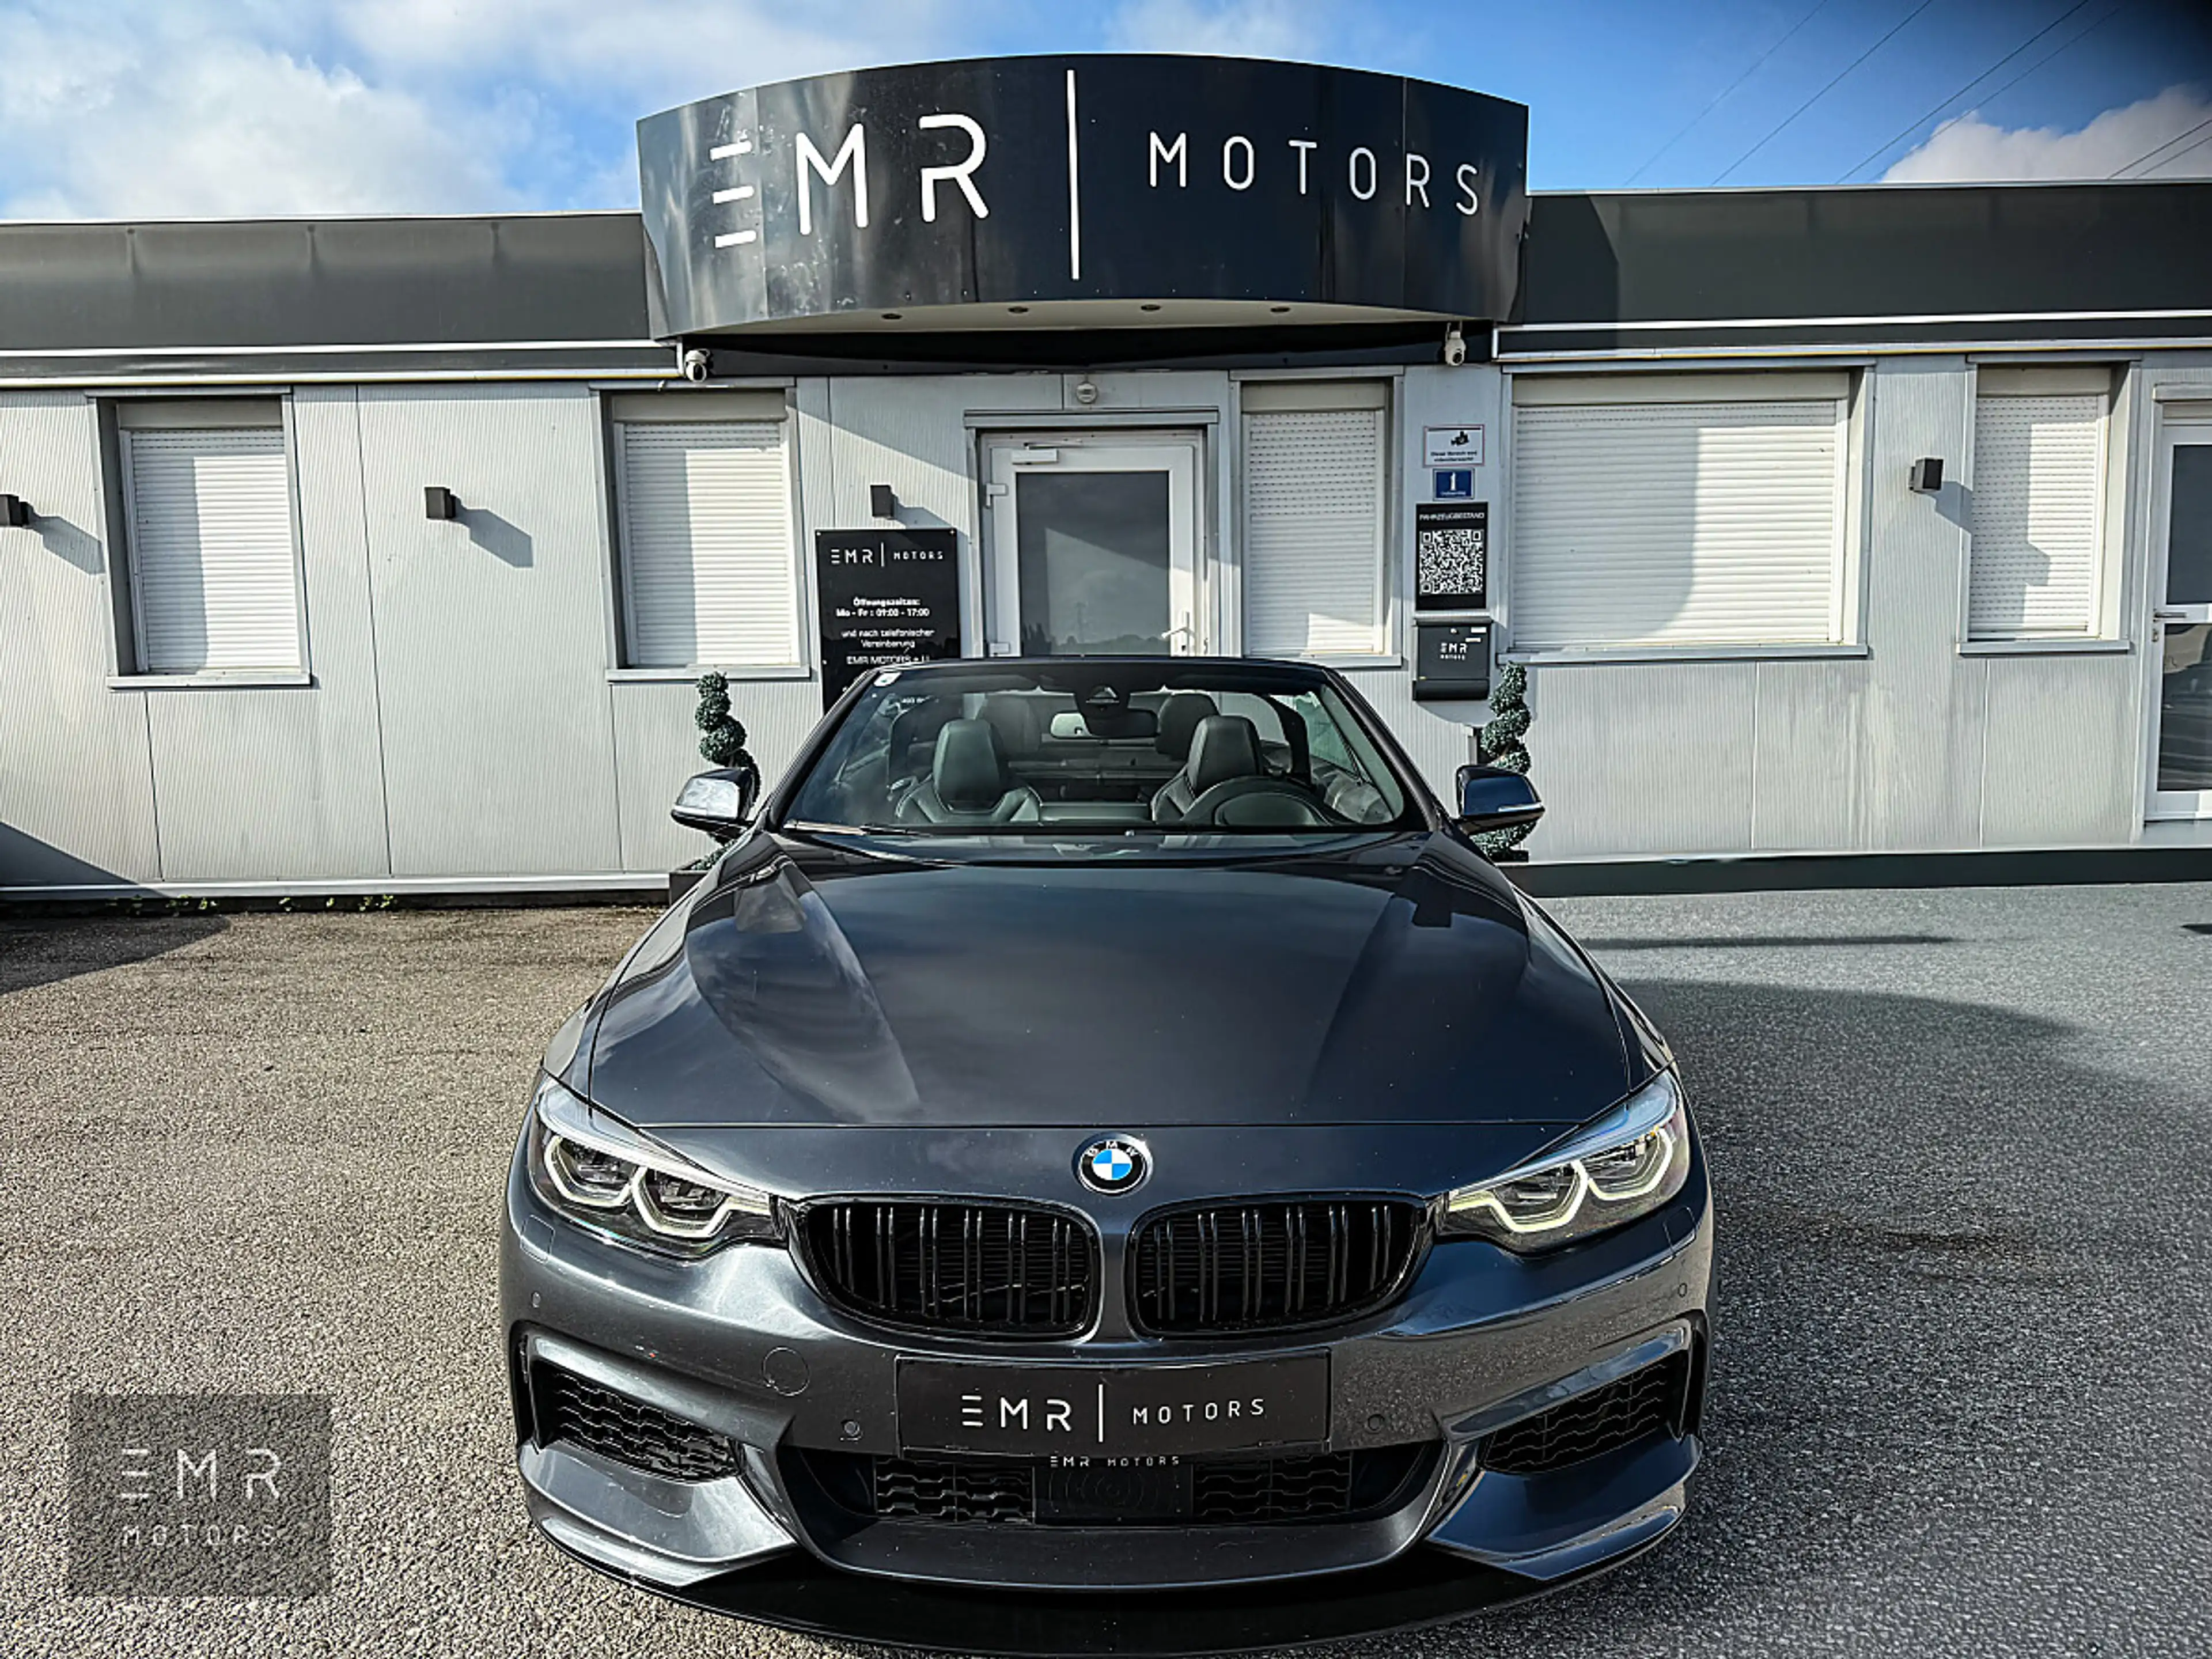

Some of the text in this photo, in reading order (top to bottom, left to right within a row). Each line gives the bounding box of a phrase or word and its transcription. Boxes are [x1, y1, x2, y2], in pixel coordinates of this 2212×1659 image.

[710, 115, 1478, 248] EMR MOTORS
[1450, 472, 1456, 491] 1
[831, 549, 943, 564] EMR MOTORS
[836, 608, 850, 616] Mo
[858, 608, 868, 616] Fr
[907, 608, 930, 616] 17:00
[961, 1395, 1264, 1431] EMR MOTORS
[1050, 1456, 1179, 1467] EMR MOTORS
